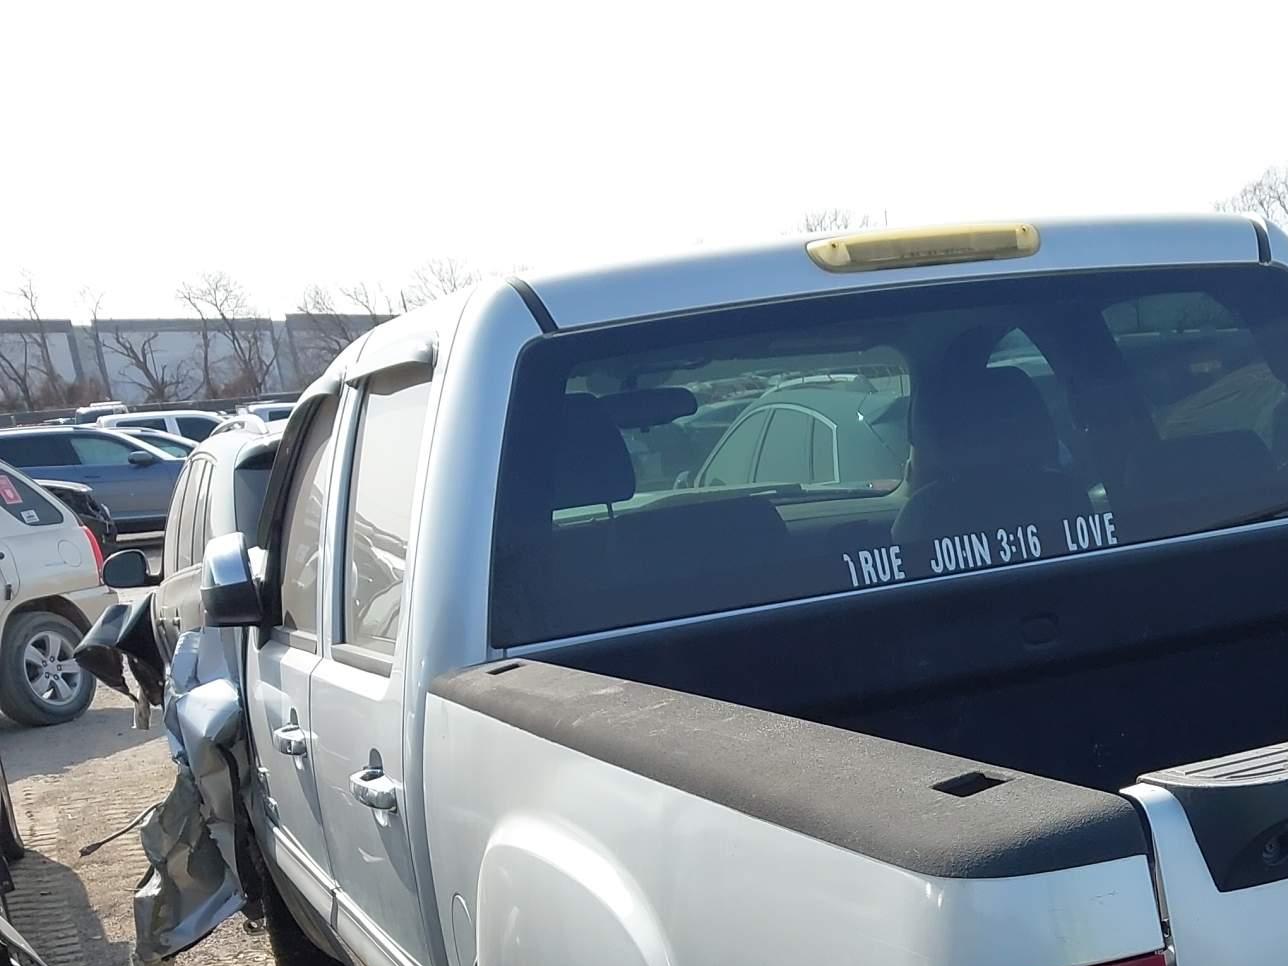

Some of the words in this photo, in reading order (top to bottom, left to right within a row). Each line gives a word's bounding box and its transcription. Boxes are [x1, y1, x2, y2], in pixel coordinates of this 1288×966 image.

[931, 532, 991, 573] JOHN
[997, 524, 1042, 563] 3:16
[1063, 512, 1118, 551] LOVE
